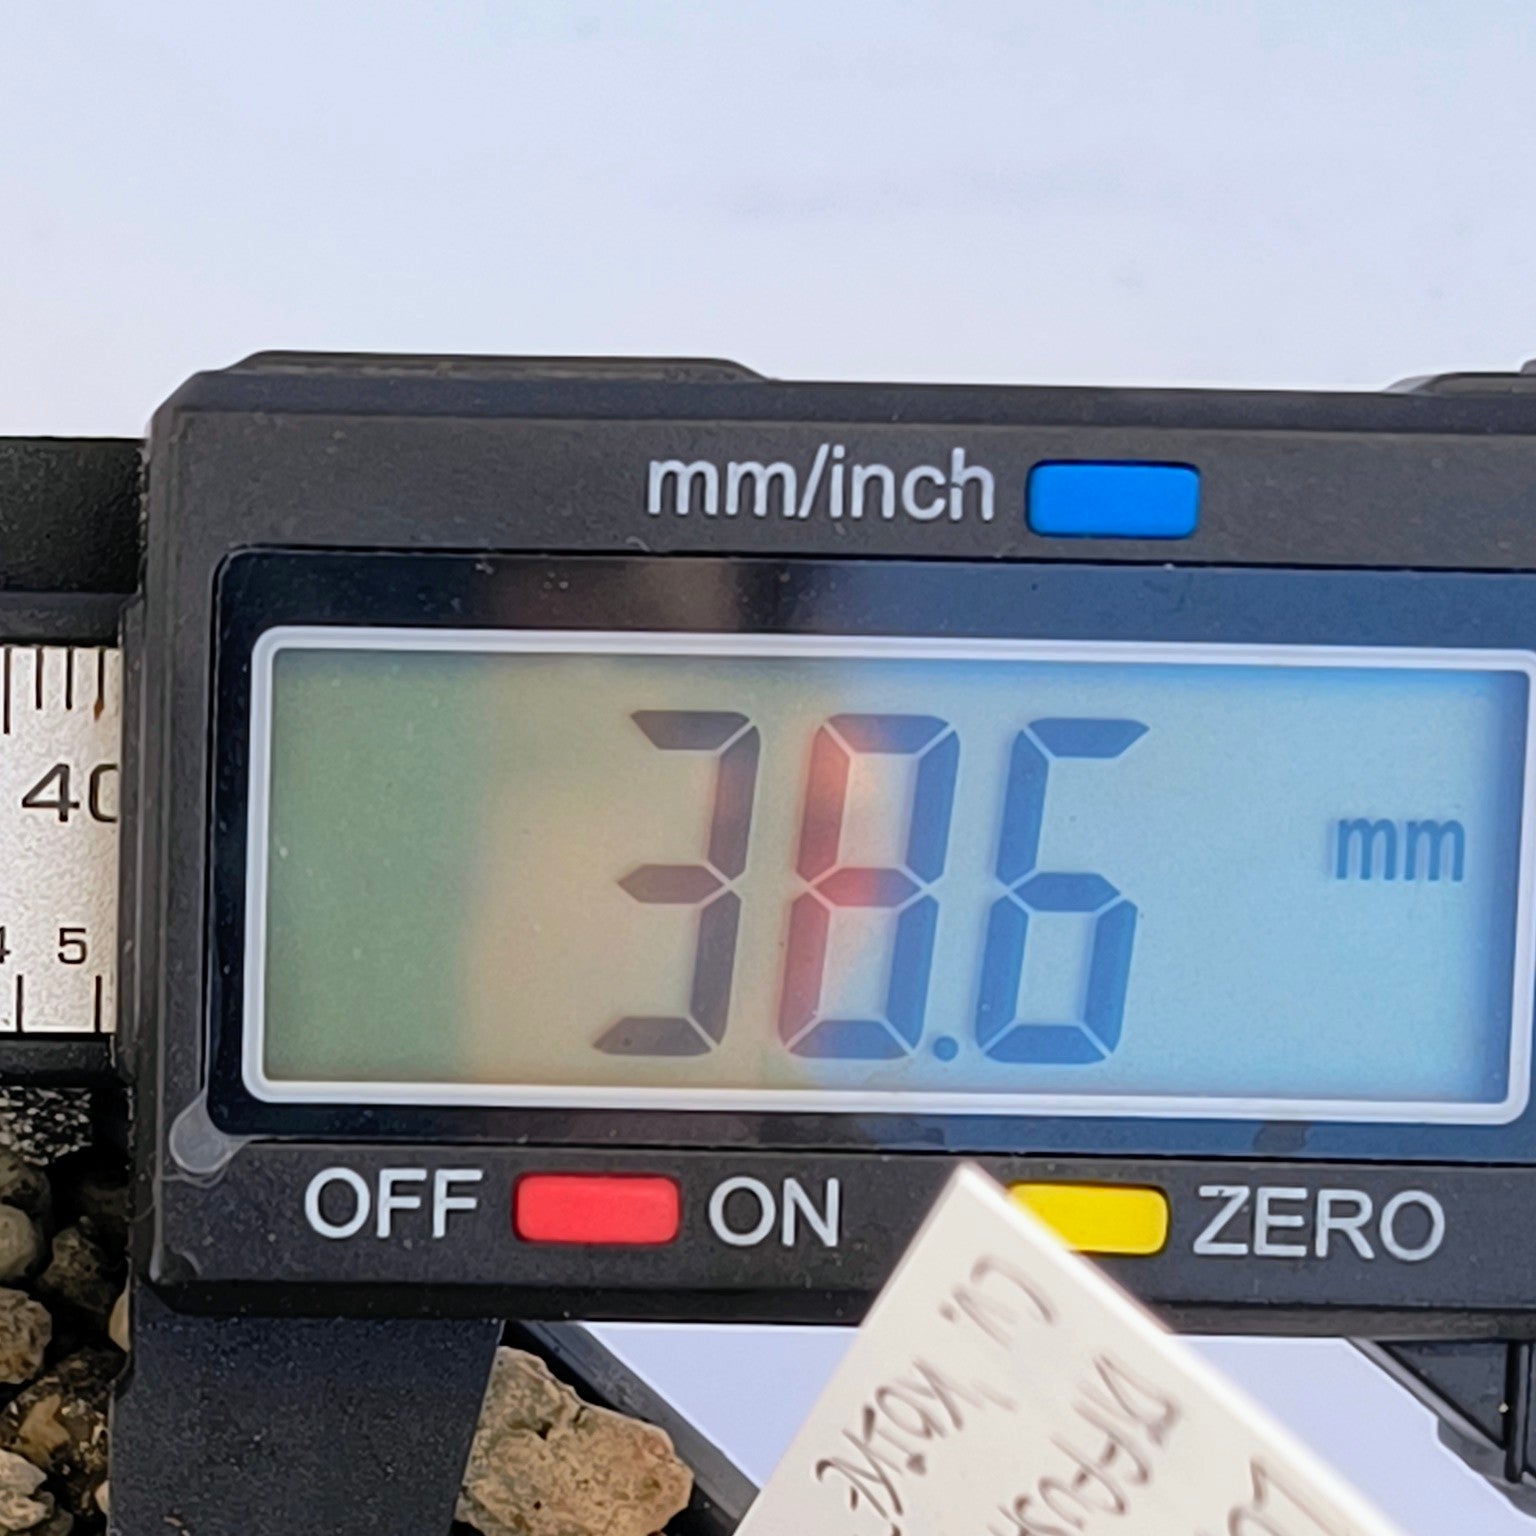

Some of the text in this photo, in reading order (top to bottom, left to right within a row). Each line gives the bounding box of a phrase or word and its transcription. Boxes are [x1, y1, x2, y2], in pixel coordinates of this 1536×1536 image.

[647, 443, 996, 521] mm/inch
[592, 710, 1464, 1065] 38.6 mm
[57, 927, 88, 965] 5
[305, 1166, 484, 1239] OFF
[708, 1176, 840, 1248] ON
[1192, 1184, 1447, 1262] ZERO
